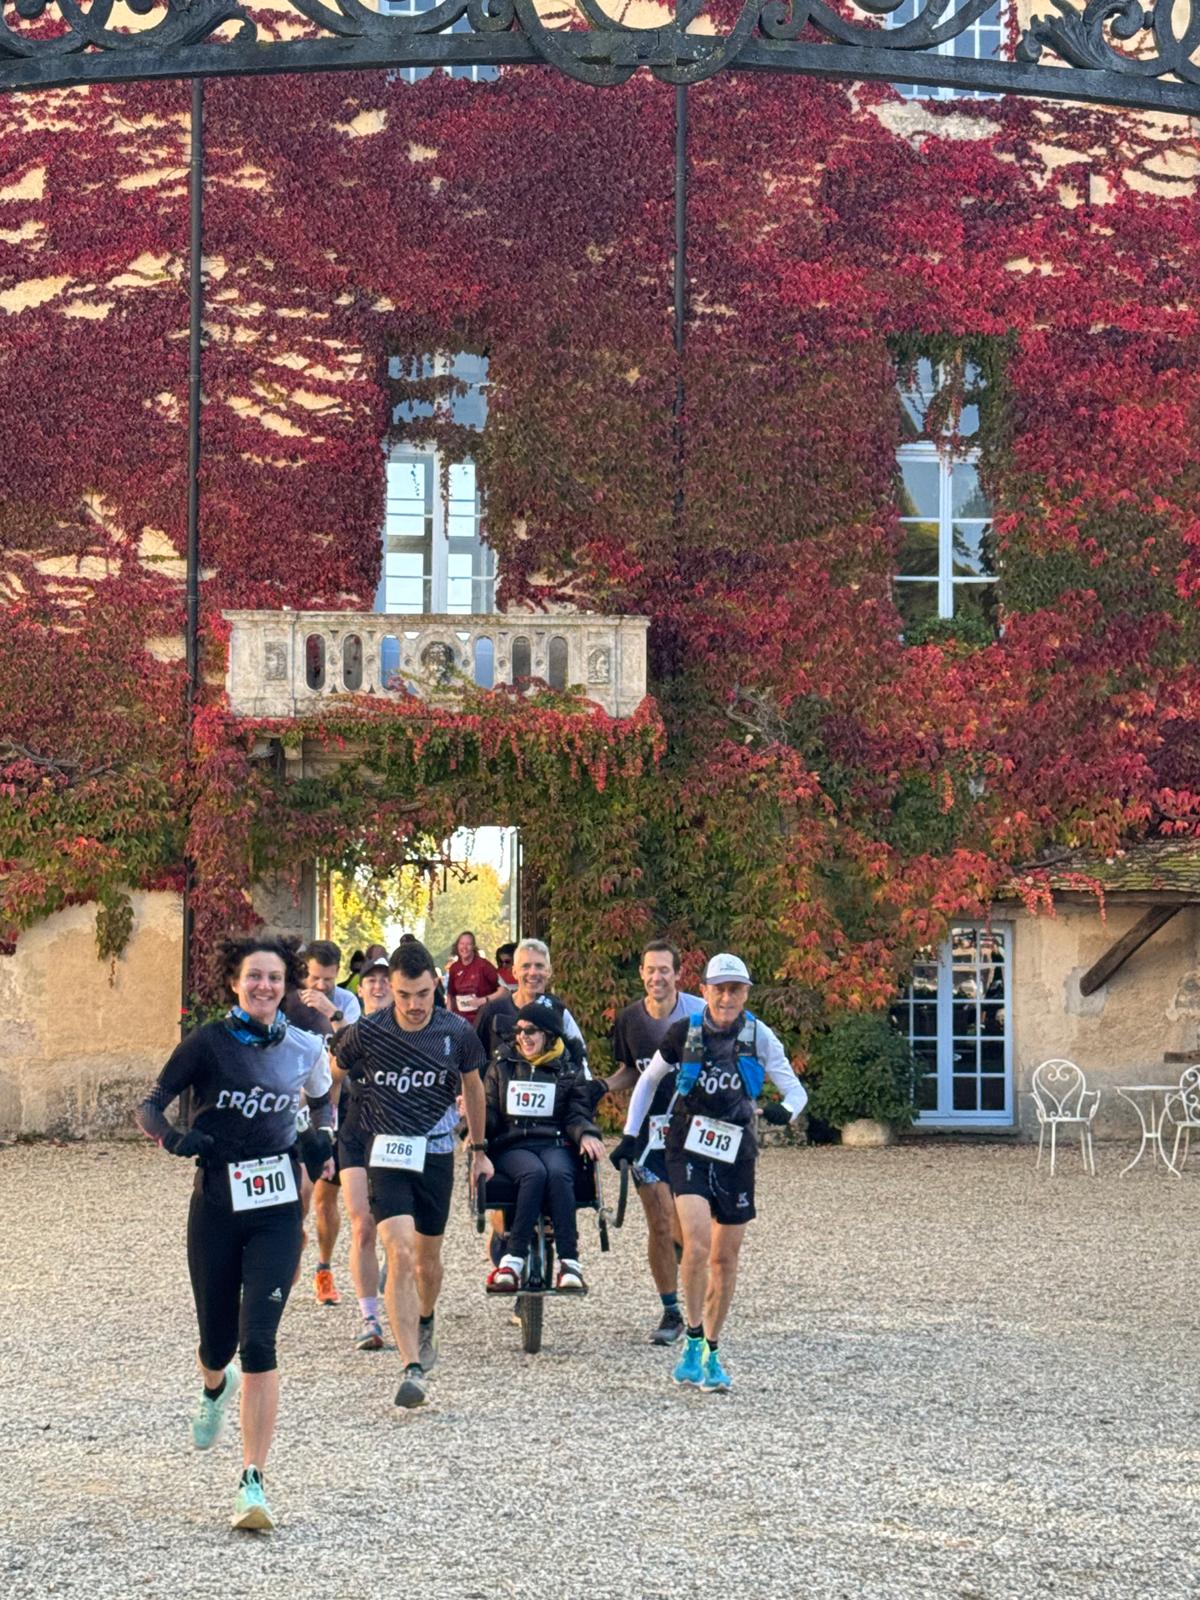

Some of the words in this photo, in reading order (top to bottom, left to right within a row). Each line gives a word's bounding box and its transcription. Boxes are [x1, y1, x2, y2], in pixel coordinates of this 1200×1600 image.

[515, 1091, 546, 1109] 1972
[385, 1142, 413, 1157] 1266
[698, 1128, 732, 1152] 1913
[242, 1170, 286, 1197] 1910
